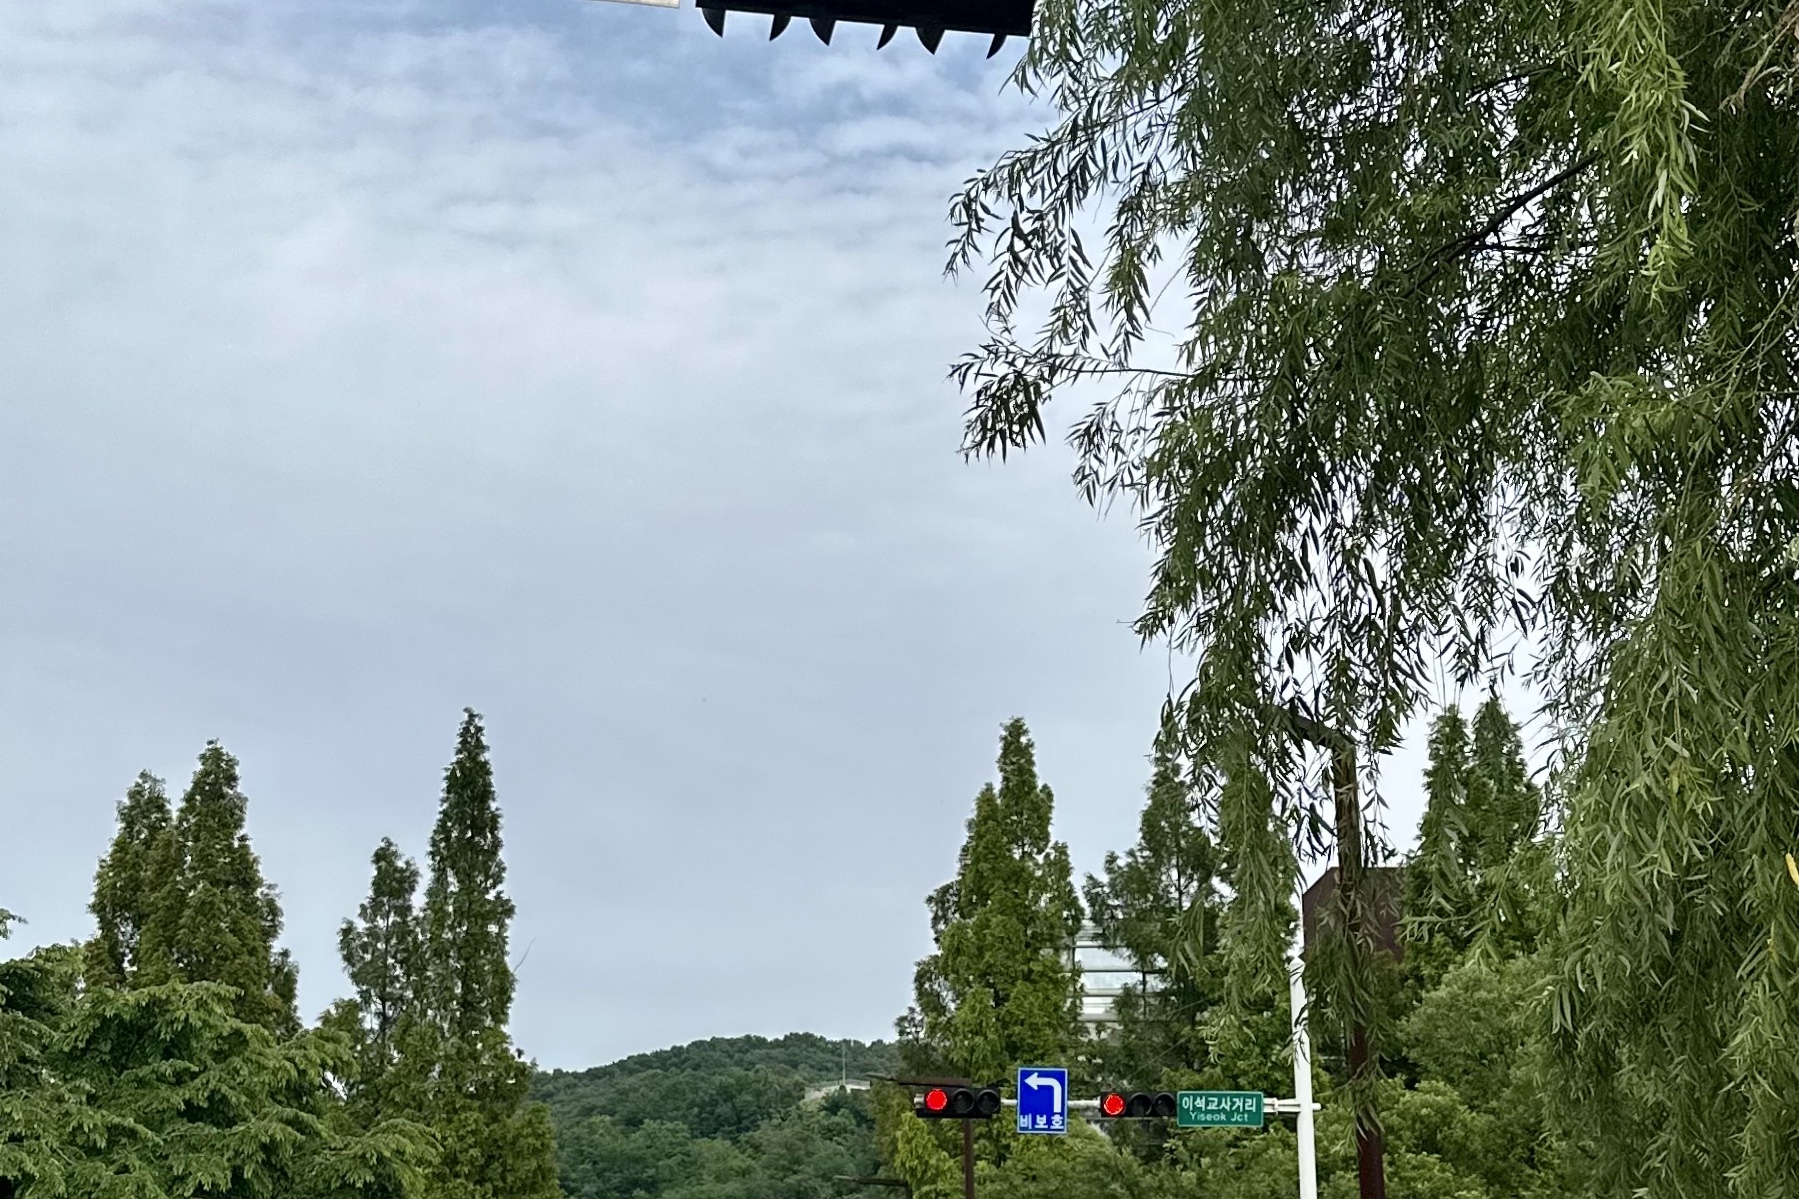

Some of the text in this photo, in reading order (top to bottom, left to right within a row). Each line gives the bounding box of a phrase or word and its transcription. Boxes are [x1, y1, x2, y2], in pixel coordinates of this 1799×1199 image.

[1182, 1095, 1256, 1112] 이석교사거리
[1019, 1113, 1064, 1130] 비보호
[1189, 1111, 1249, 1122] Yiseok Jct
